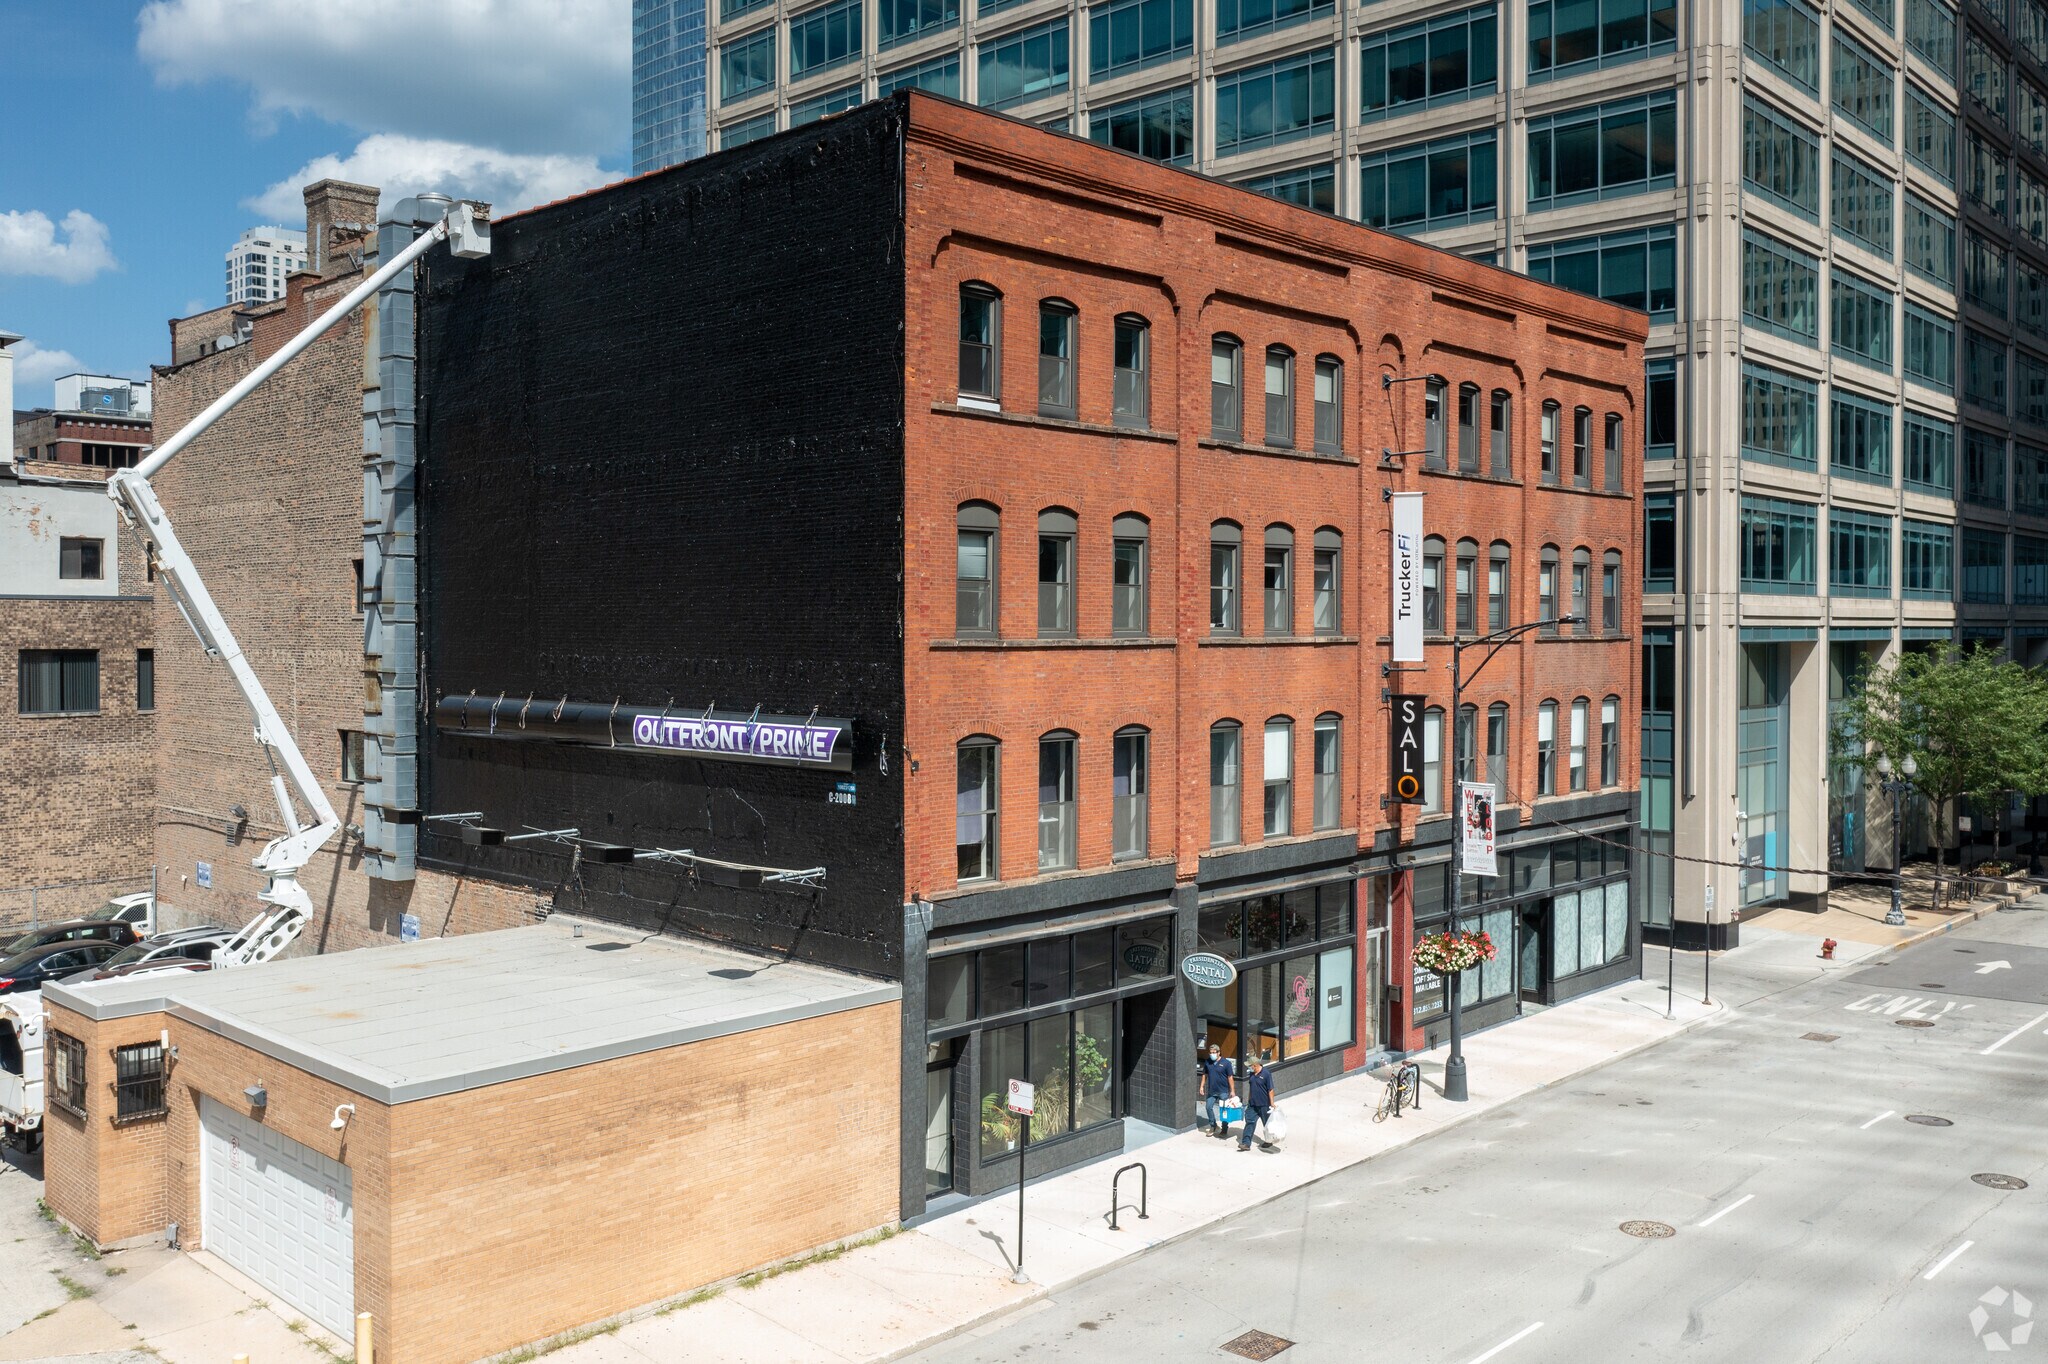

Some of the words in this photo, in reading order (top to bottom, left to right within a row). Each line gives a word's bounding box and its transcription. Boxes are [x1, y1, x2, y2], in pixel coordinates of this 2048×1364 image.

[1398, 534, 1411, 620] TruckerFi
[638, 719, 748, 750] OUTFRONT
[760, 728, 829, 757] PRIME
[1188, 963, 1227, 979] DENTAL
[1190, 956, 1227, 970] PRESIDENTIAL
